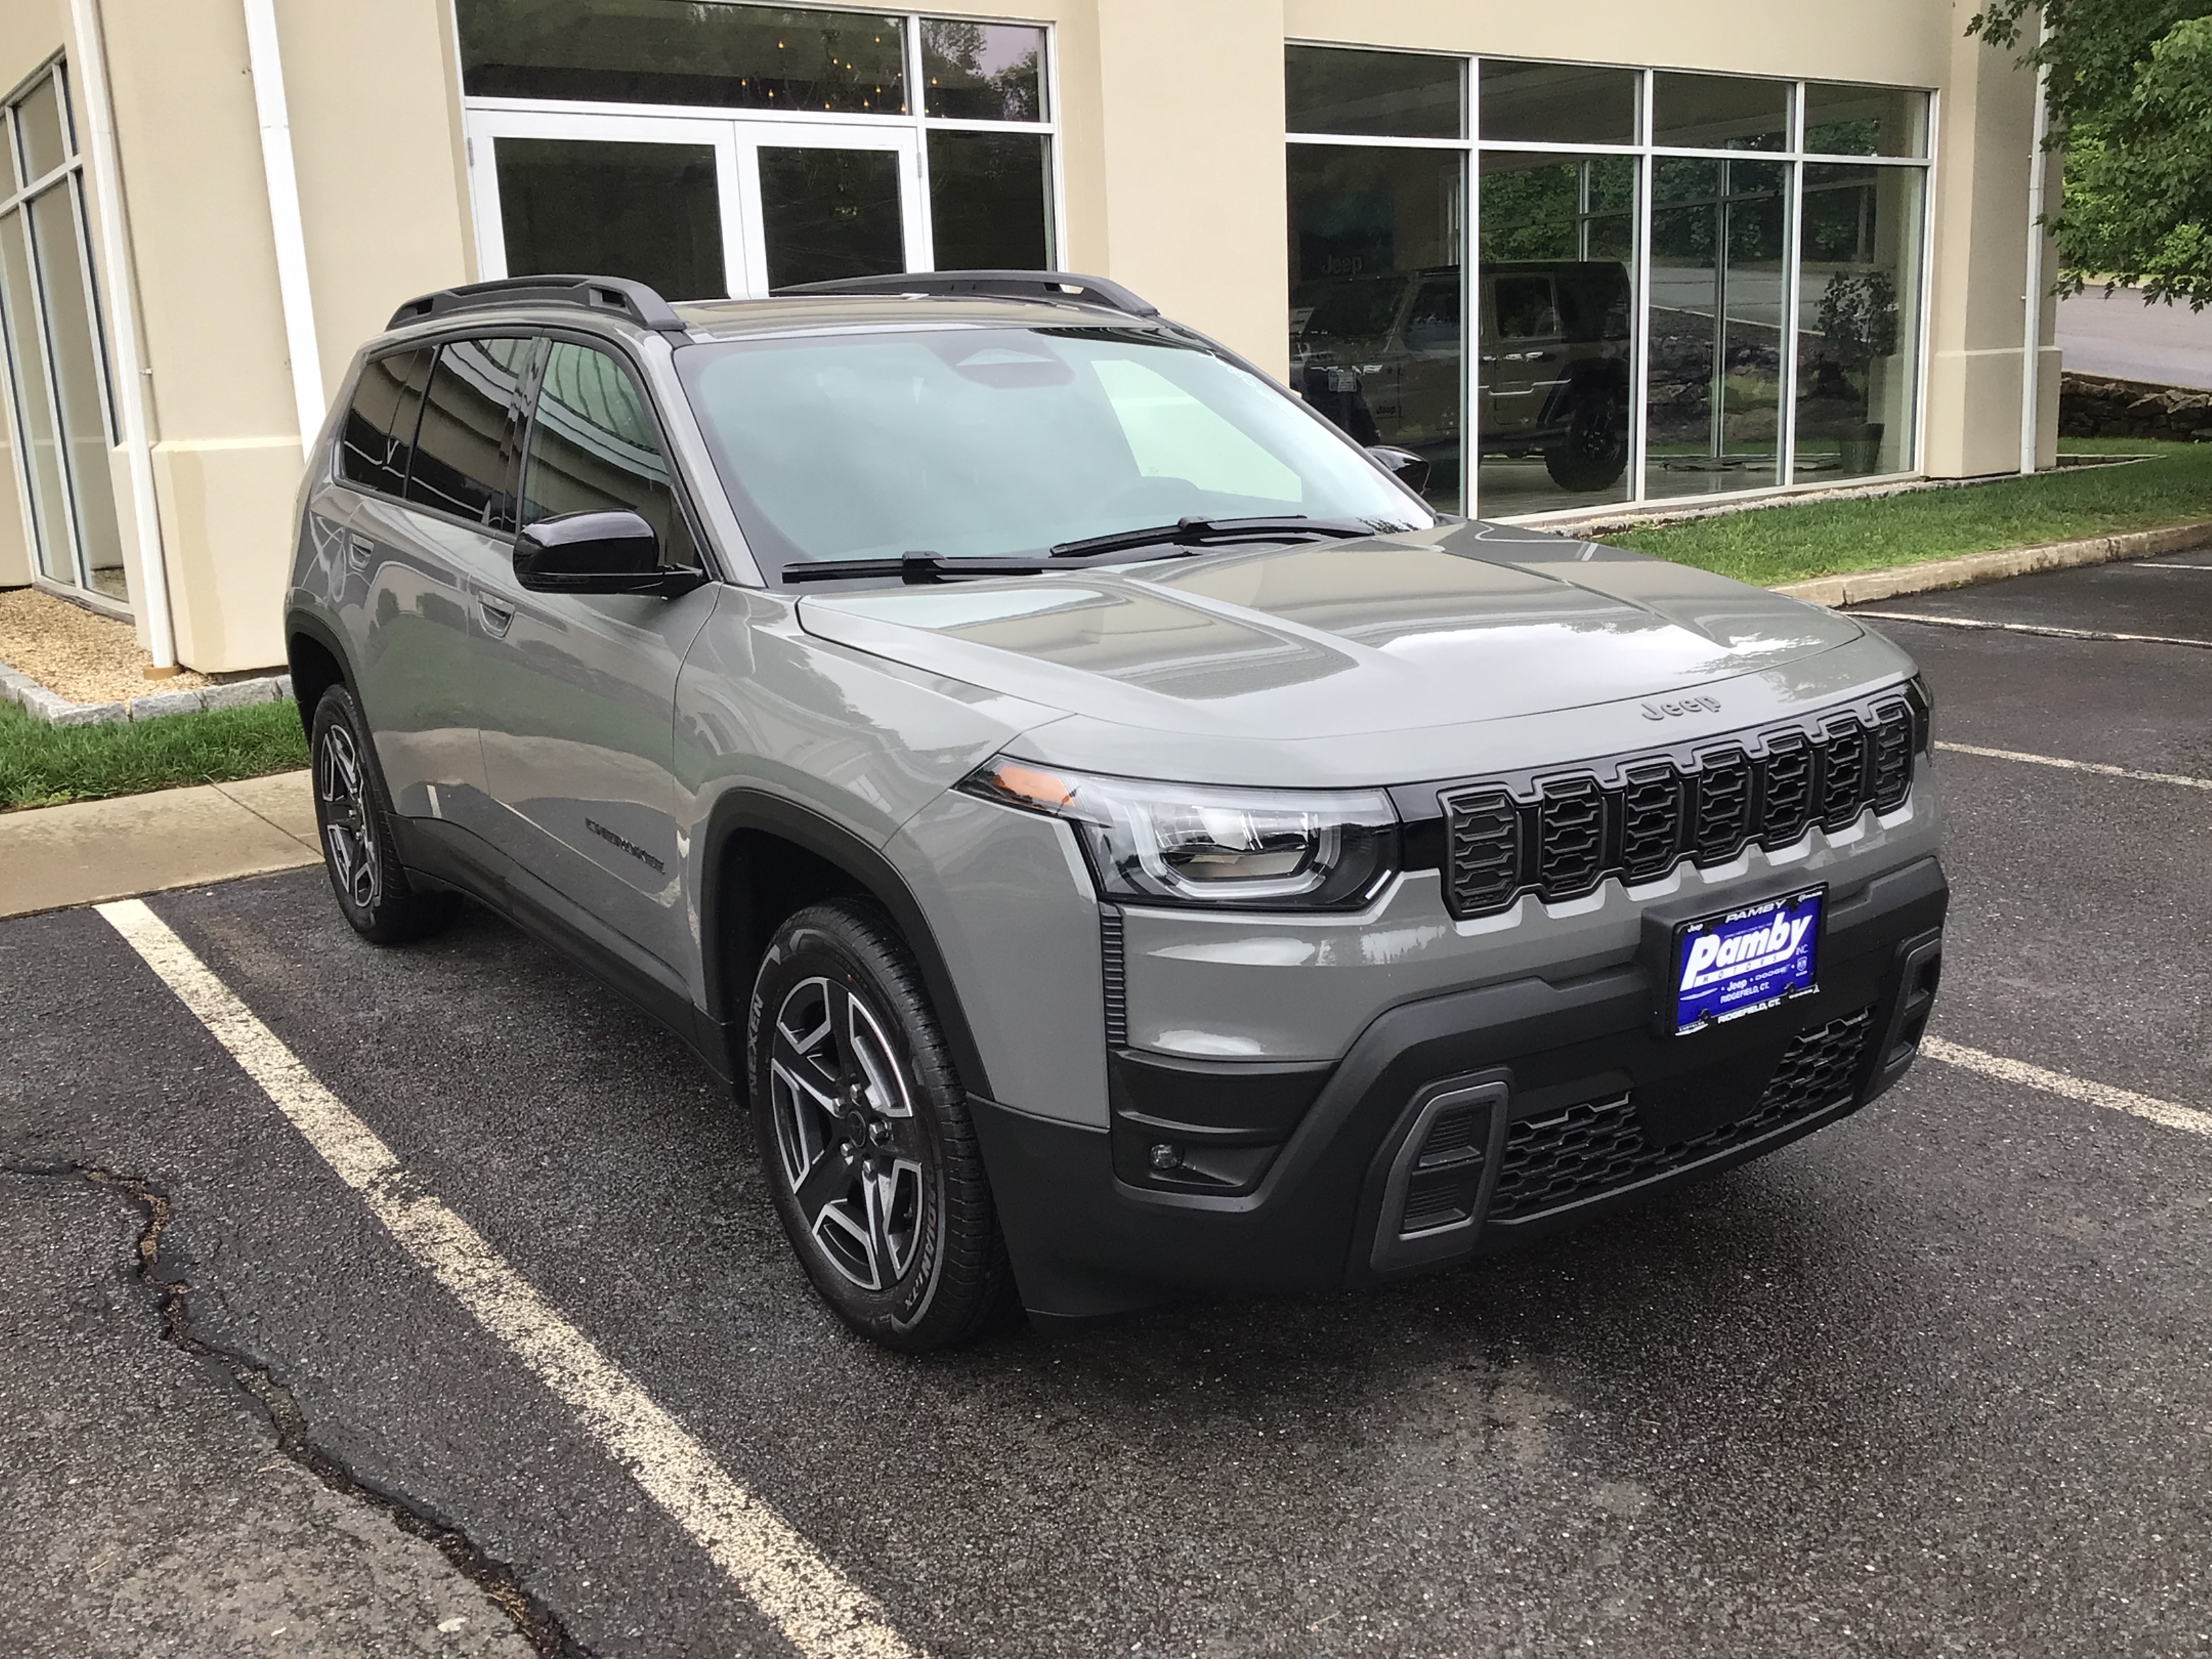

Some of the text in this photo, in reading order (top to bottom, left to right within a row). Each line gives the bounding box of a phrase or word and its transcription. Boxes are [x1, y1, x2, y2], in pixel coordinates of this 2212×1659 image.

[1641, 695, 1721, 720] Jeep
[1725, 899, 1786, 924] PAMBY
[1687, 924, 1703, 933] Jeep
[1679, 912, 1813, 991] Pamby
[1702, 954, 1777, 983] MOTORS
[1720, 985, 1759, 1004] RIDGEFIELD,
[1727, 979, 1747, 991] Jeep
[1717, 998, 1781, 1024] RIDGEFIELD, CT.
[747, 992, 764, 1096] NEXEN
